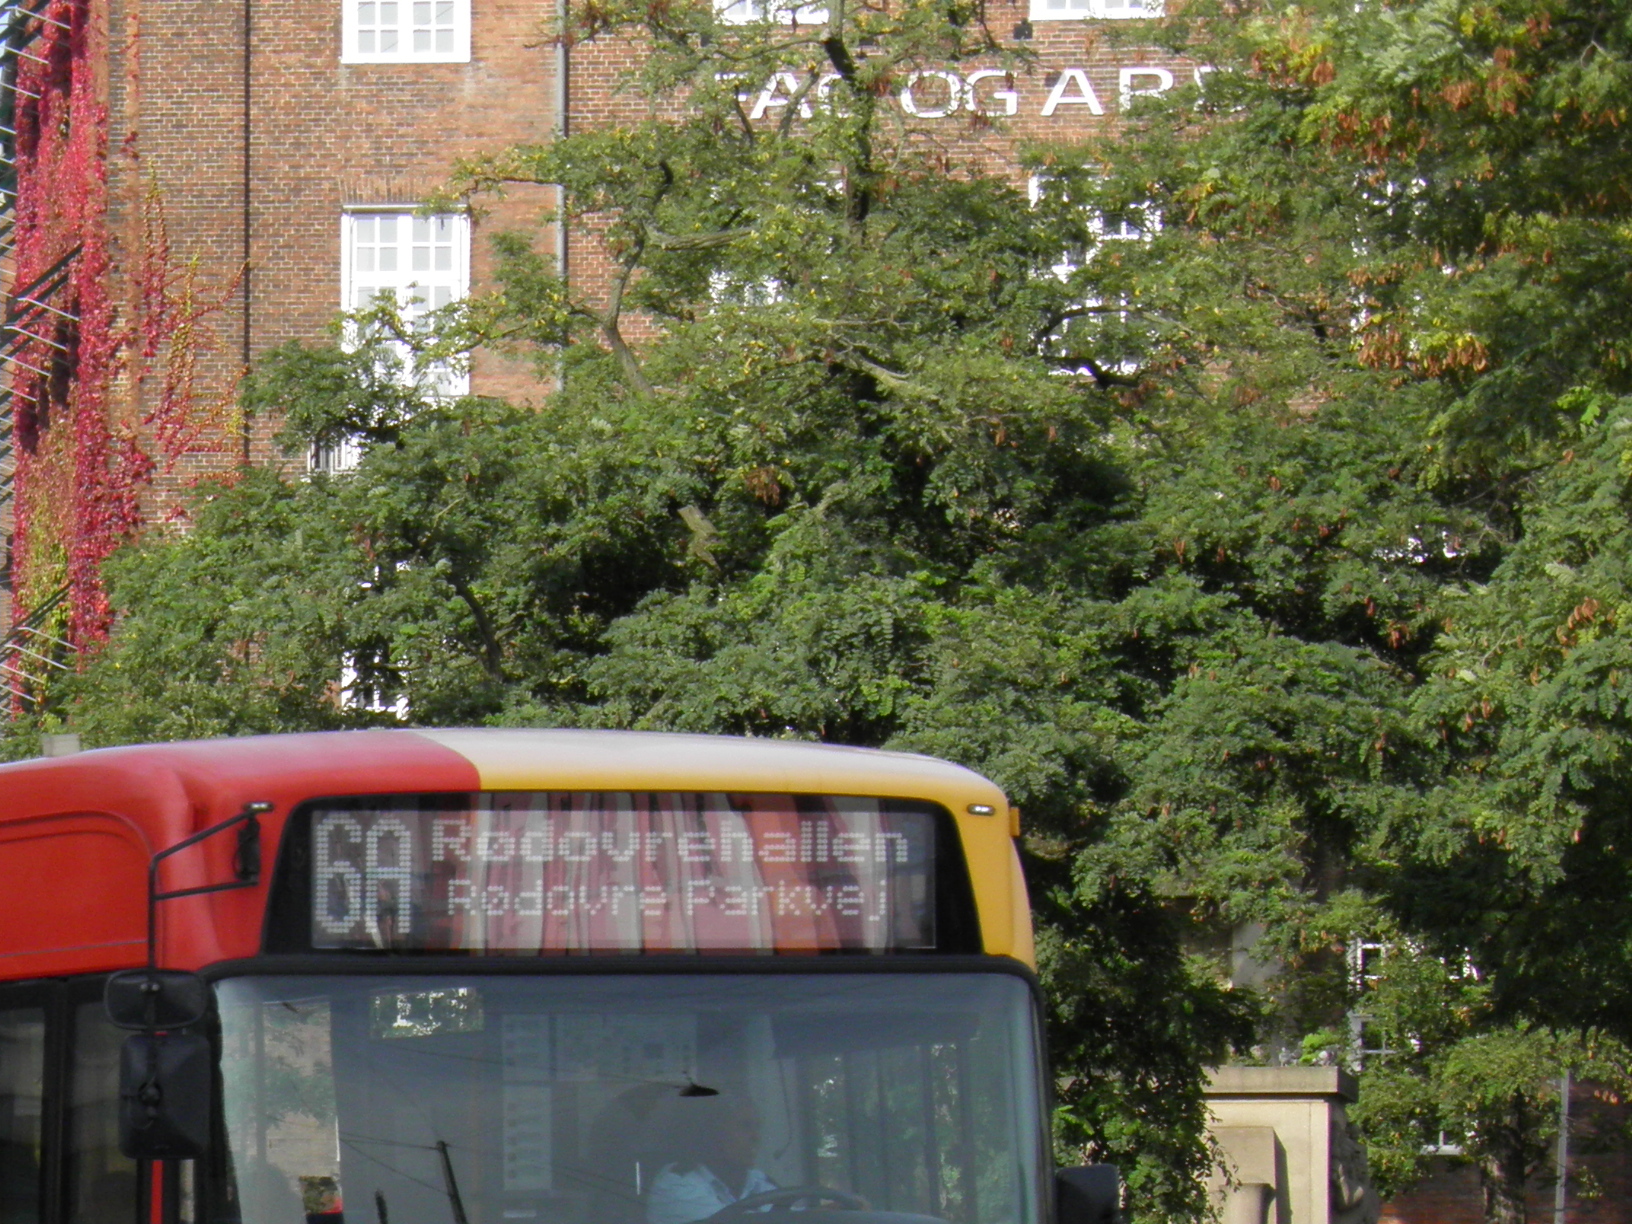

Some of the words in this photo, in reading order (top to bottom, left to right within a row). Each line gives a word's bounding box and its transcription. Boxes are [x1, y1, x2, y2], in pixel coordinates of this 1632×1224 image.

[432, 818, 908, 863] Rødovrehallen
[316, 813, 412, 934] 6A
[447, 878, 667, 916] Rødovre
[687, 878, 887, 921] Parkvej
